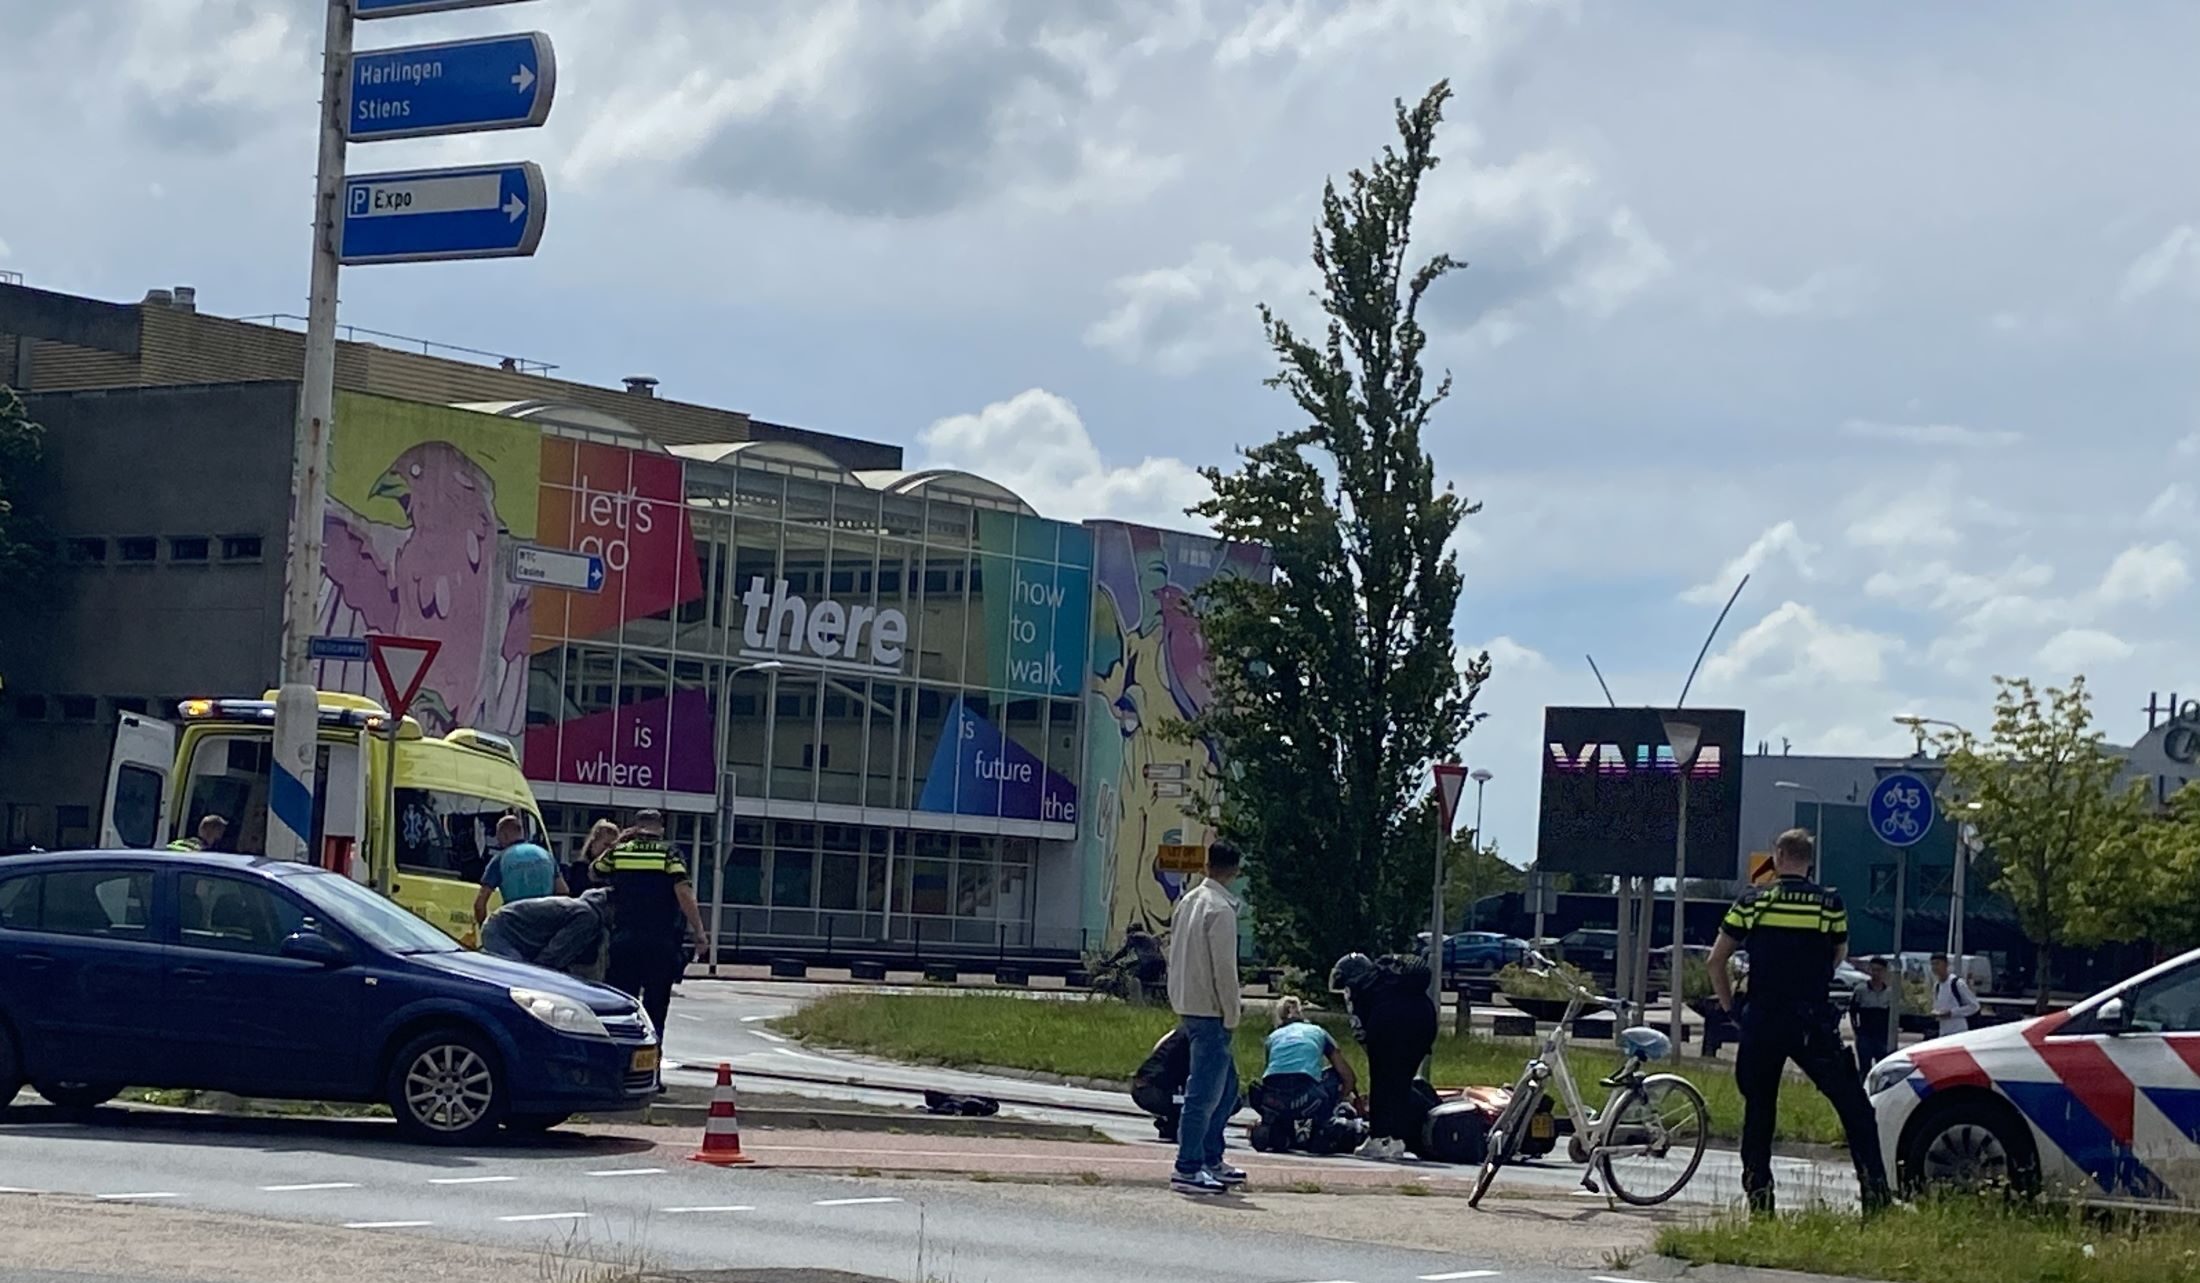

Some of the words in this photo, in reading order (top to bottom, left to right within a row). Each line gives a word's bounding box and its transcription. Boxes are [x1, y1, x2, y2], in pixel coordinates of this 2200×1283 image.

[361, 61, 442, 86] Harlingen
[358, 99, 410, 119] Stiens
[355, 189, 366, 213] P
[374, 189, 412, 210] Expo
[580, 475, 653, 533] let's
[1015, 568, 1065, 608] how
[742, 576, 908, 666] there
[1011, 613, 1036, 643] to
[1010, 650, 1062, 687] walk
[634, 718, 652, 748] is
[960, 713, 975, 739] is
[576, 751, 653, 787] where
[975, 750, 1032, 783] future
[1044, 791, 1075, 821] the
